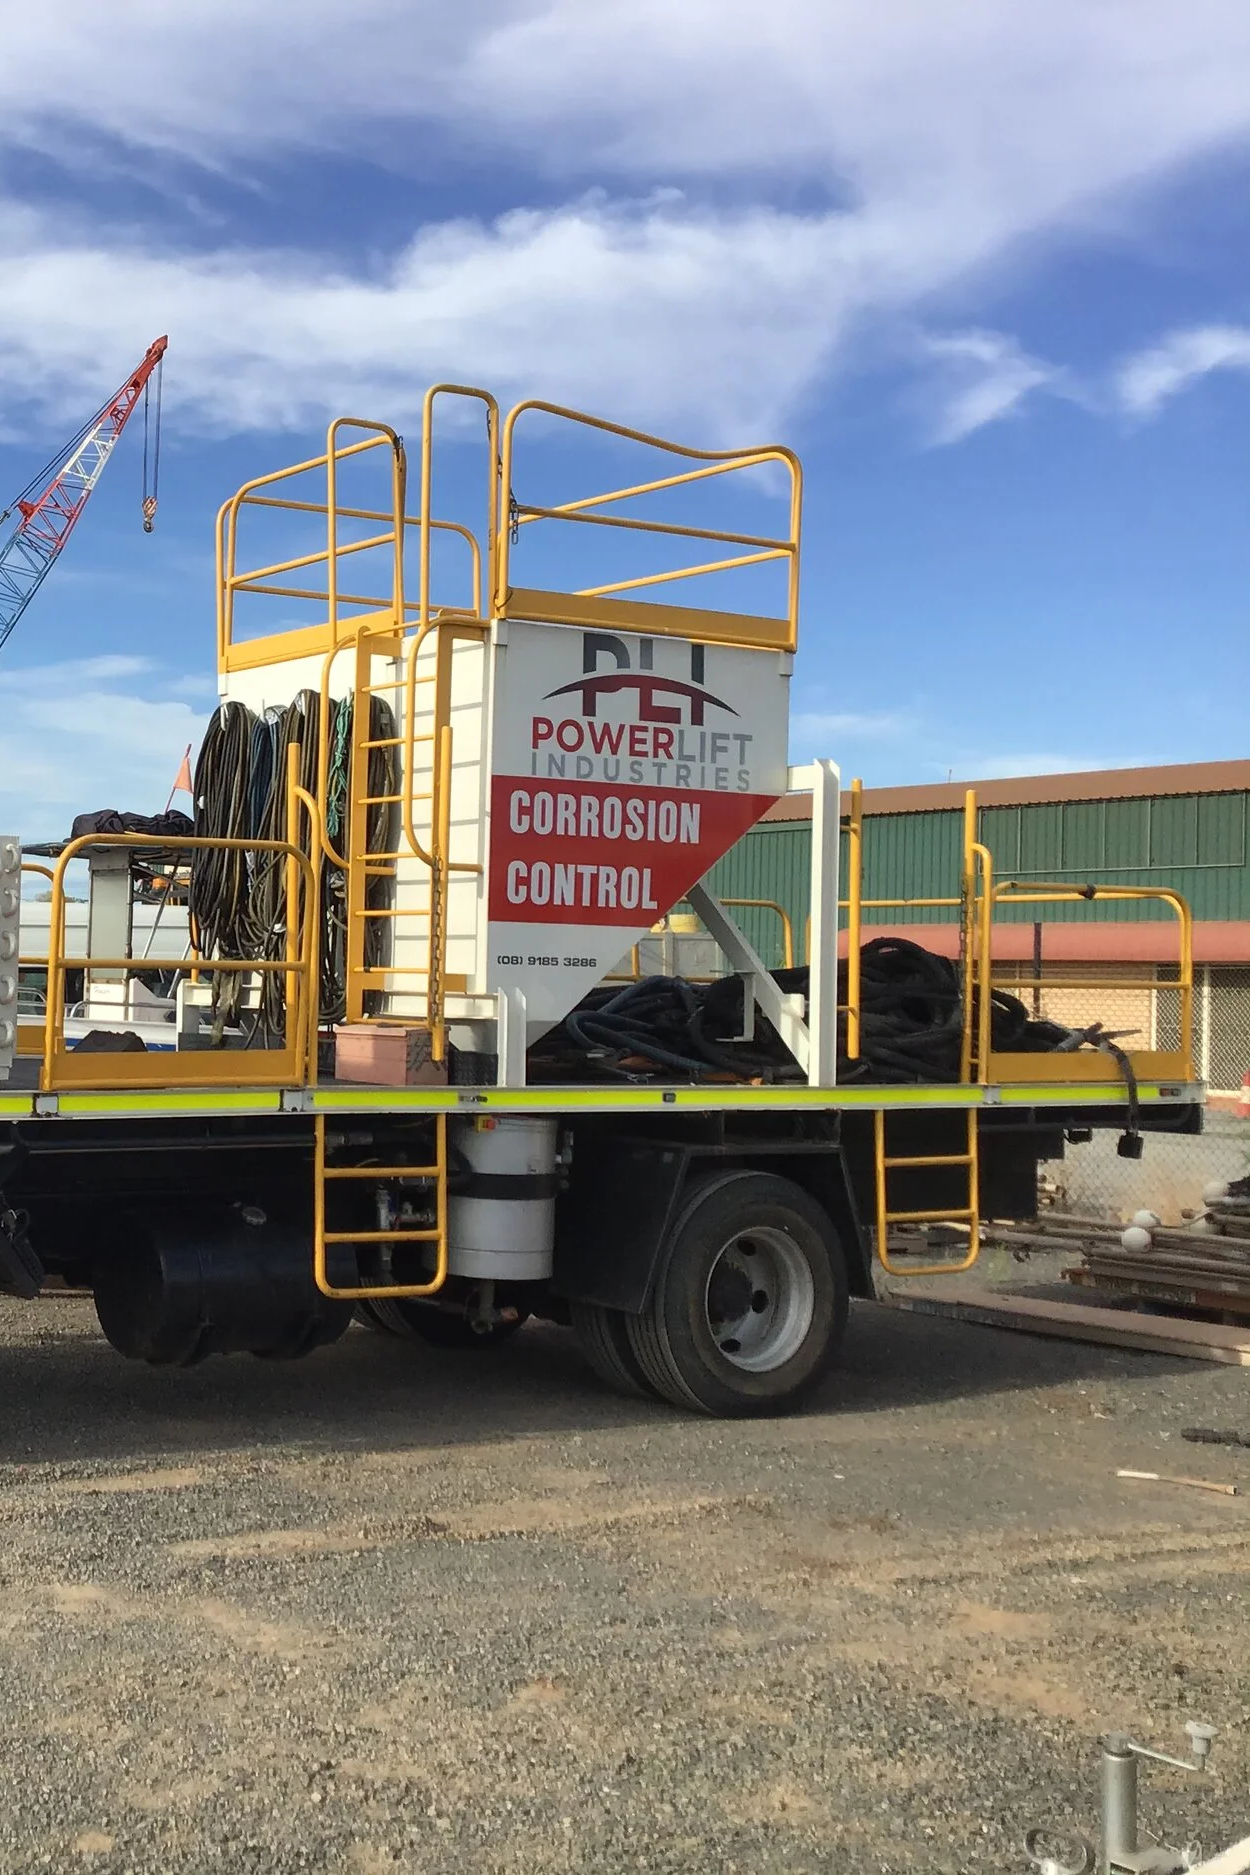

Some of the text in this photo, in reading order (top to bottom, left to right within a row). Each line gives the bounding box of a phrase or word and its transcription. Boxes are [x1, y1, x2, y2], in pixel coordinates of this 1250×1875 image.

[532, 716, 753, 765] POWERLIFT
[531, 752, 750, 792] INDUSTRIES
[510, 790, 700, 844] CORROSION
[507, 860, 658, 909] CONTROL
[497, 955, 597, 968] (08) 9185 3286
